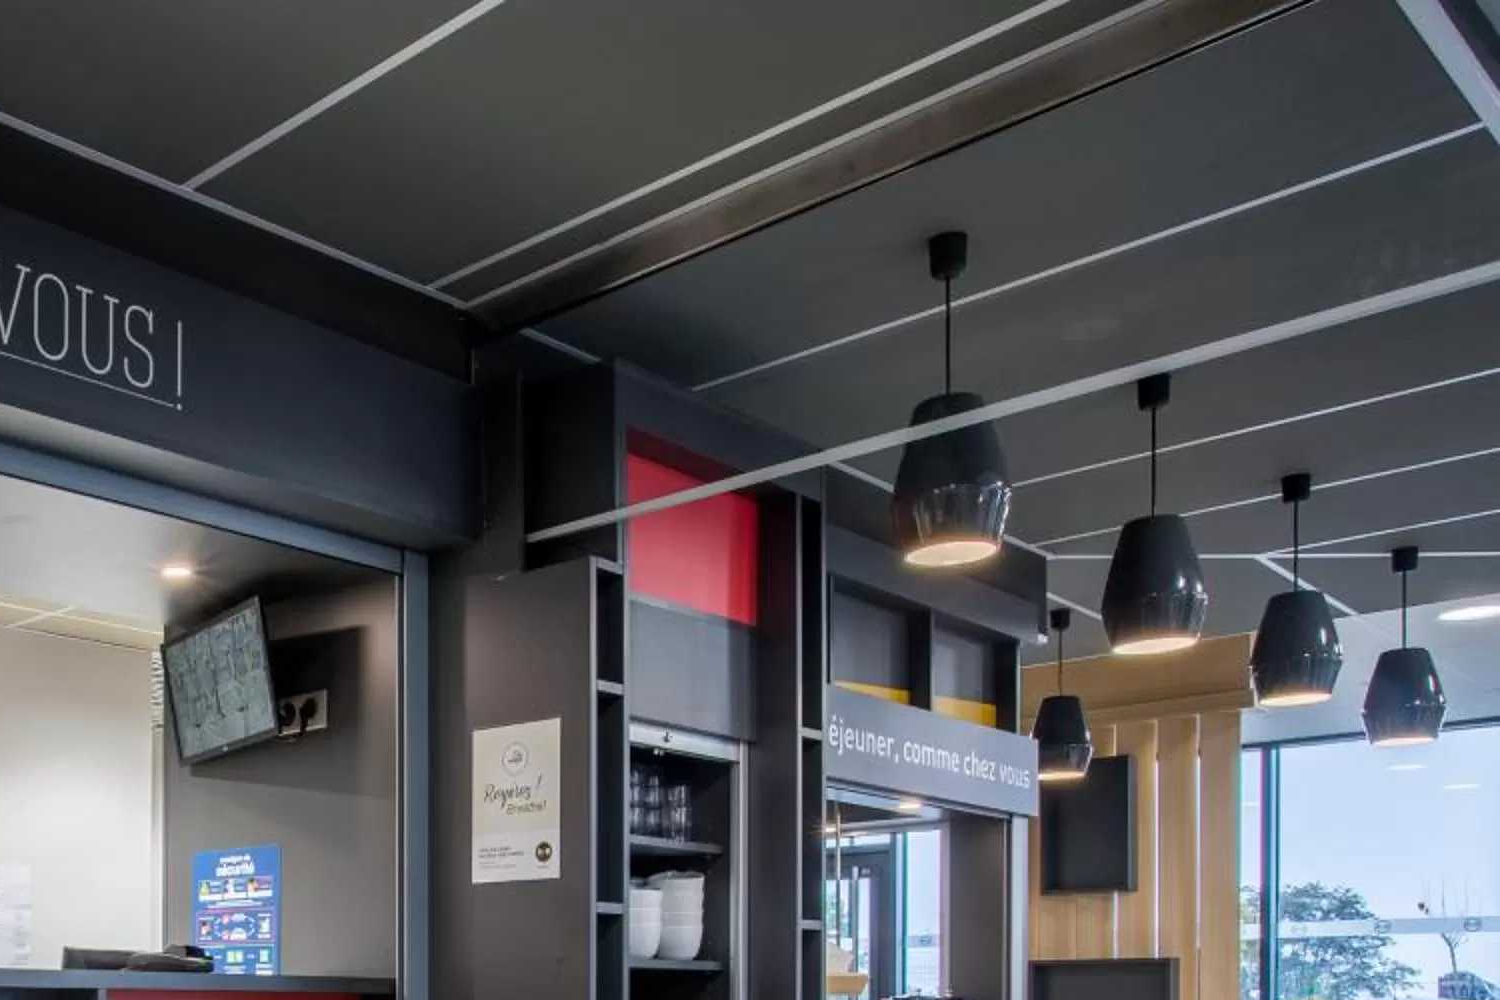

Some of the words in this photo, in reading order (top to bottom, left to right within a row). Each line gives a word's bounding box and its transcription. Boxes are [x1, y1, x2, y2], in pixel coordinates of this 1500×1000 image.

[827, 714, 899, 764] éjeuner,
[903, 740, 960, 773] comme
[962, 750, 997, 781] chez
[999, 764, 1030, 789] vous
